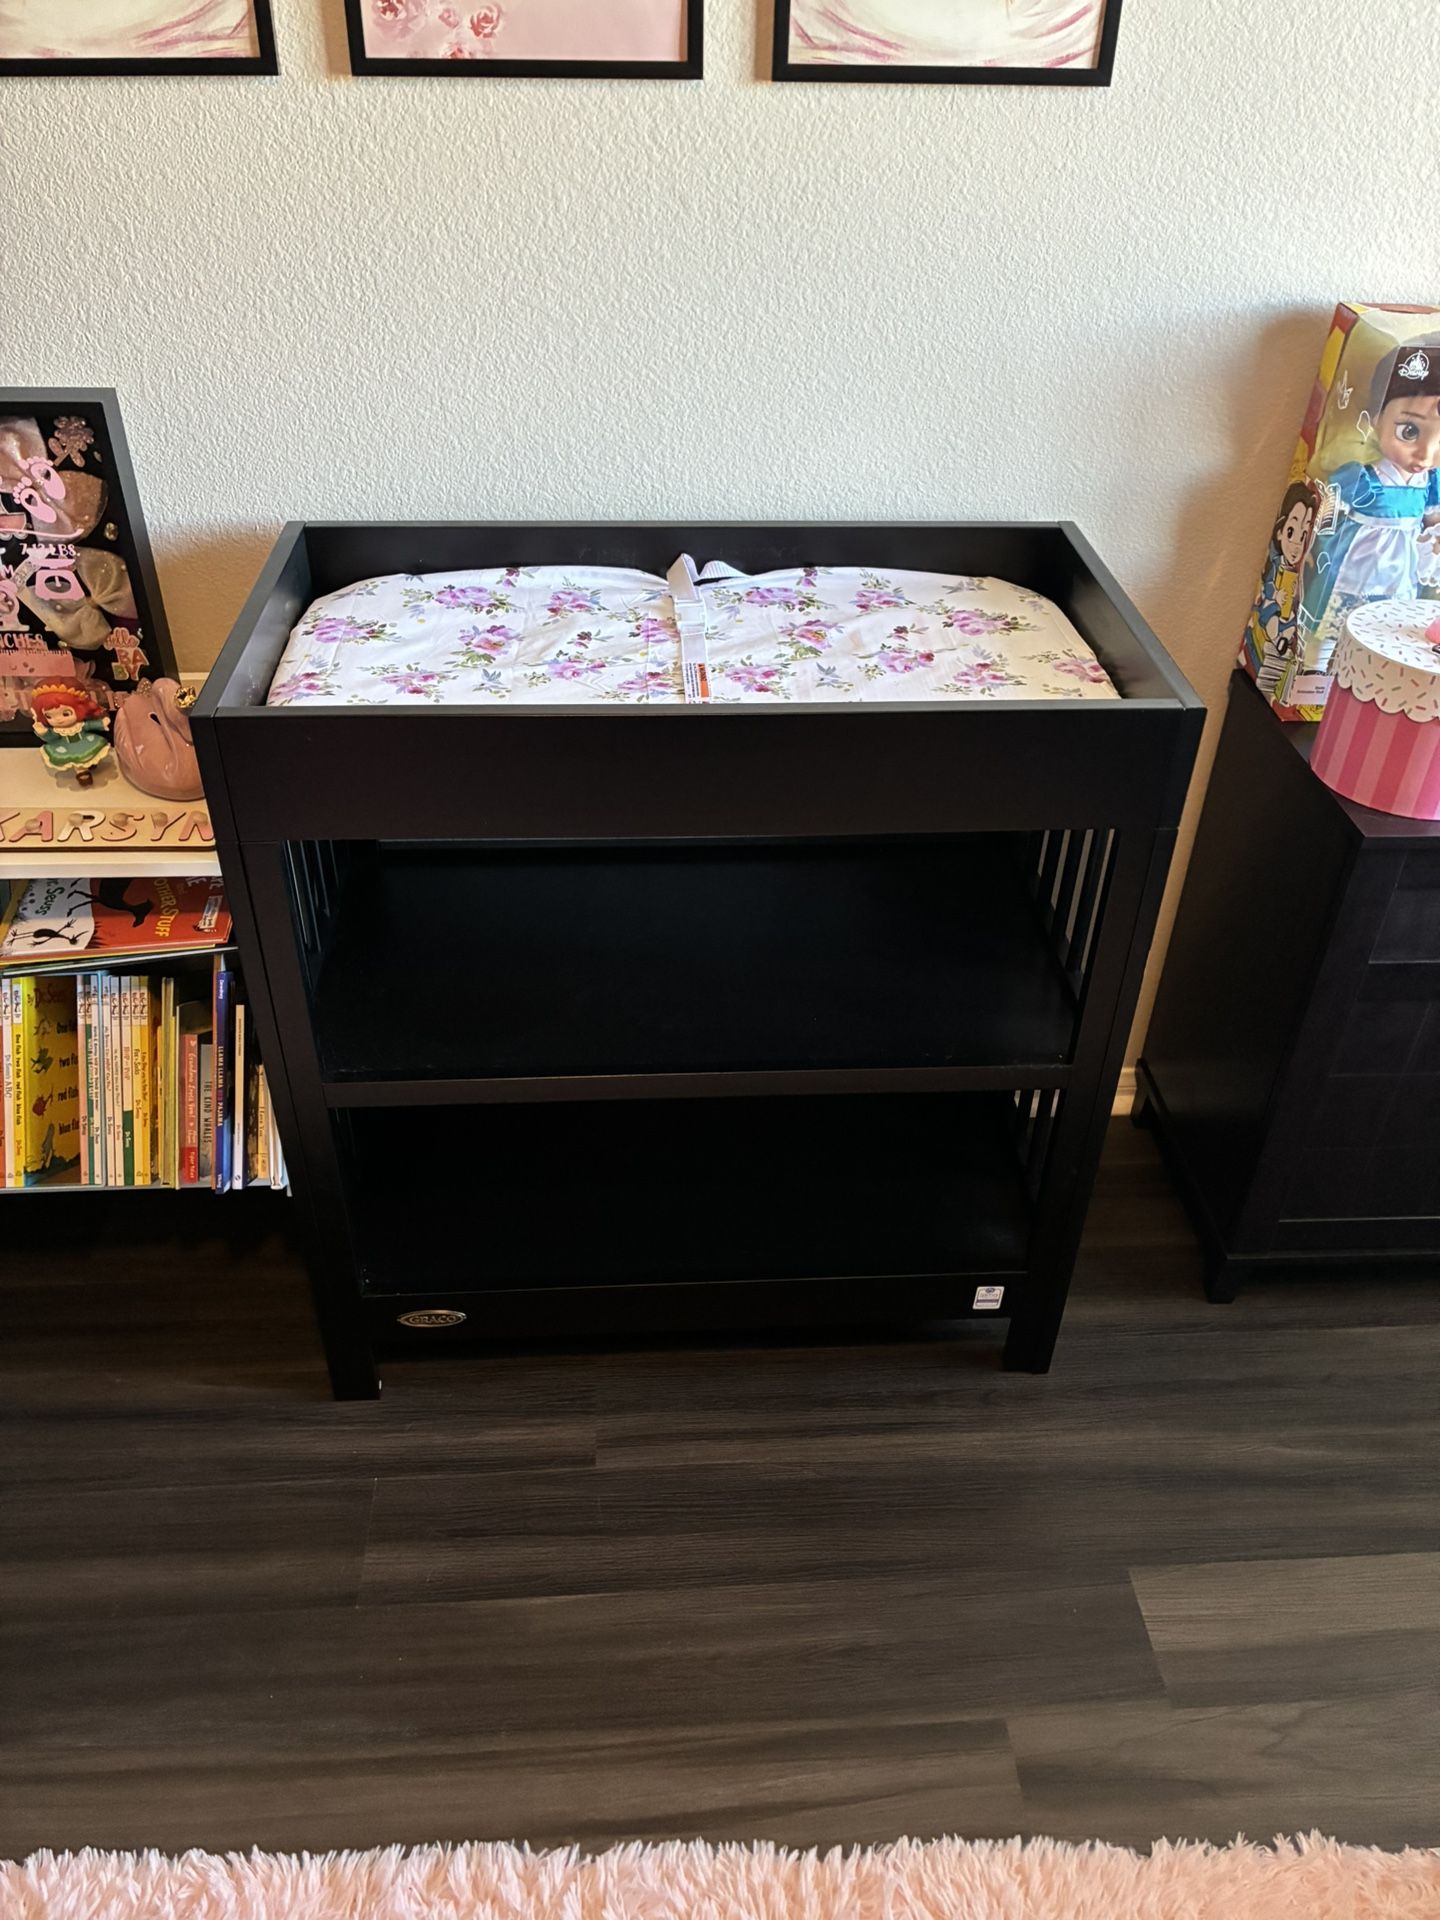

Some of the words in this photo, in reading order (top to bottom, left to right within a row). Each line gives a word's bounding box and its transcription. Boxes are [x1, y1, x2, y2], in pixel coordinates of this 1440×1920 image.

[153, 878, 176, 908] OTHER
[35, 887, 65, 915] Seuss
[155, 907, 179, 937] STUFF
[59, 1056, 70, 1067] two
[203, 1081, 213, 1092] THE
[58, 1087, 67, 1101] red
[58, 1122, 71, 1135] blue
[409, 1315, 456, 1324] GRACO
